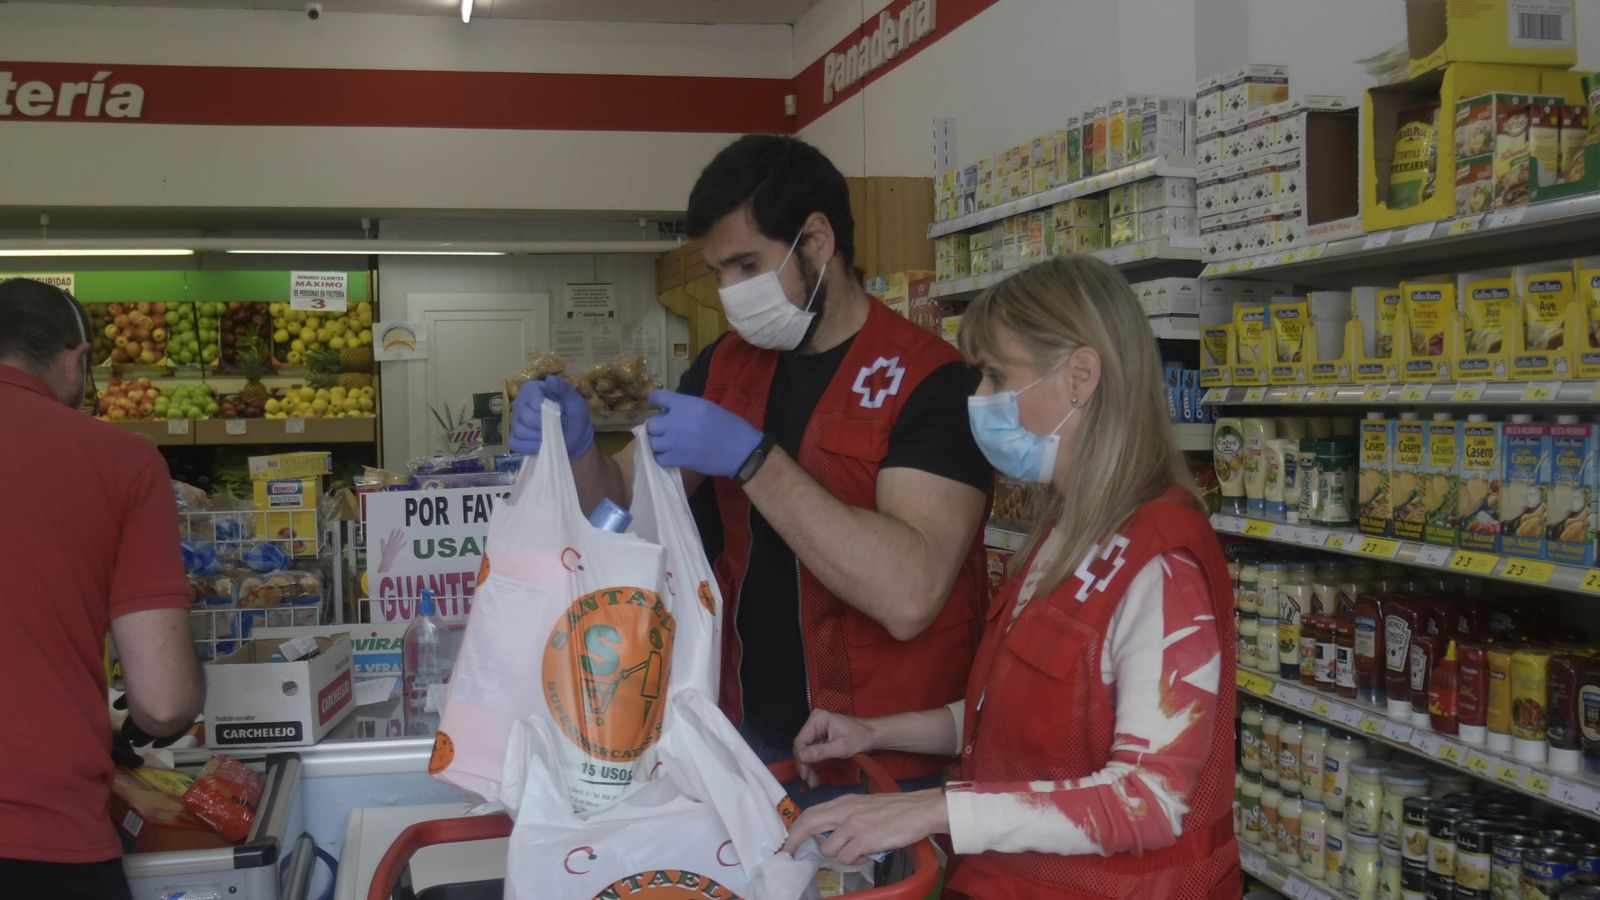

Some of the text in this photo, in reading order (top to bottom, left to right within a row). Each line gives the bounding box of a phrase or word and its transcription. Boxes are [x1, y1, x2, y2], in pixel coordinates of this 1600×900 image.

[311, 298, 326, 309] 3
[1398, 440, 1422, 454] Casero
[1465, 444, 1494, 458] Casero
[1511, 453, 1538, 465] Casero
[404, 492, 512, 527] POR FAV
[413, 536, 487, 560] USA
[379, 571, 476, 622] GUANTE
[223, 727, 296, 739] CARCHELEJO
[582, 762, 596, 777] 15
